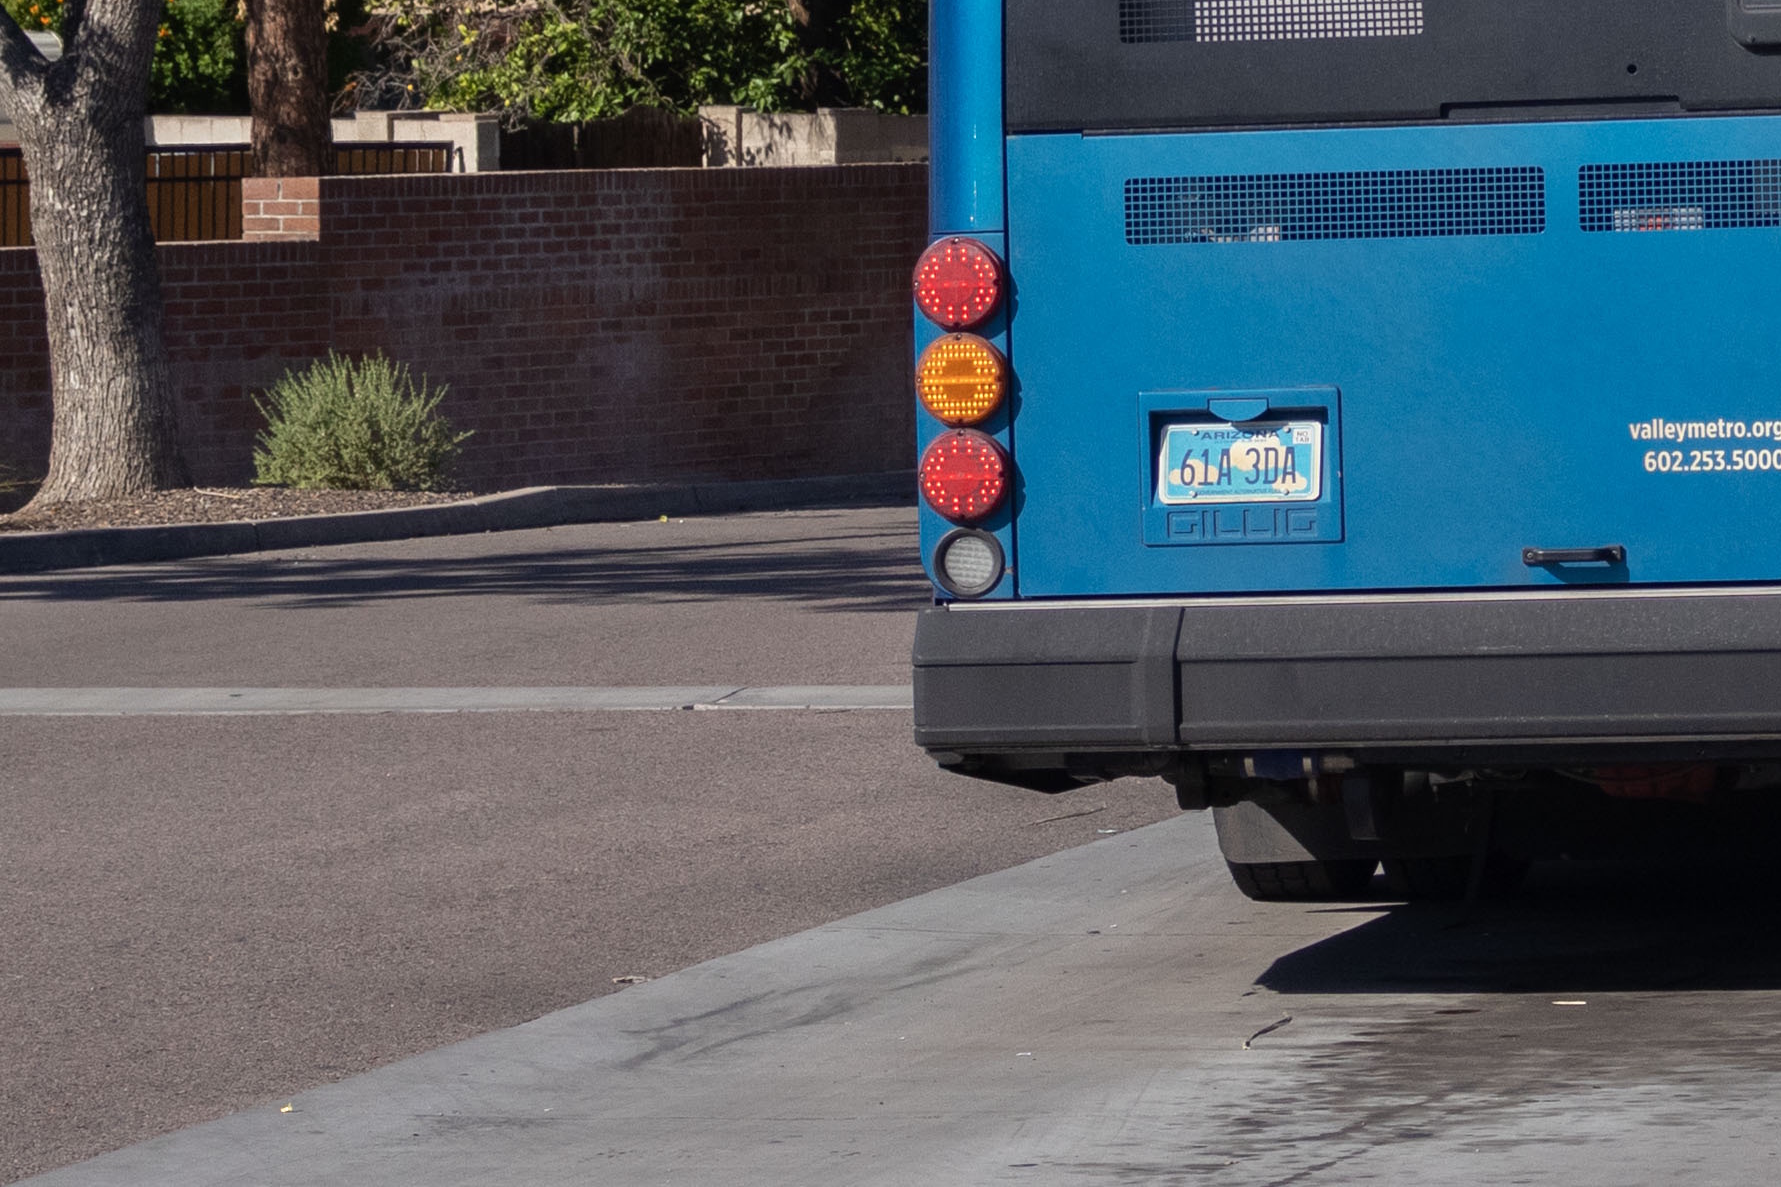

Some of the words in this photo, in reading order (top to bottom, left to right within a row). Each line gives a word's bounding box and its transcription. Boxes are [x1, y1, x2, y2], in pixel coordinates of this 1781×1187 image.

[1200, 429, 1281, 441] ARIZONA
[1180, 448, 1232, 486] 61A
[1245, 447, 1297, 485] 3DA
[1166, 507, 1319, 540] GILLIG
